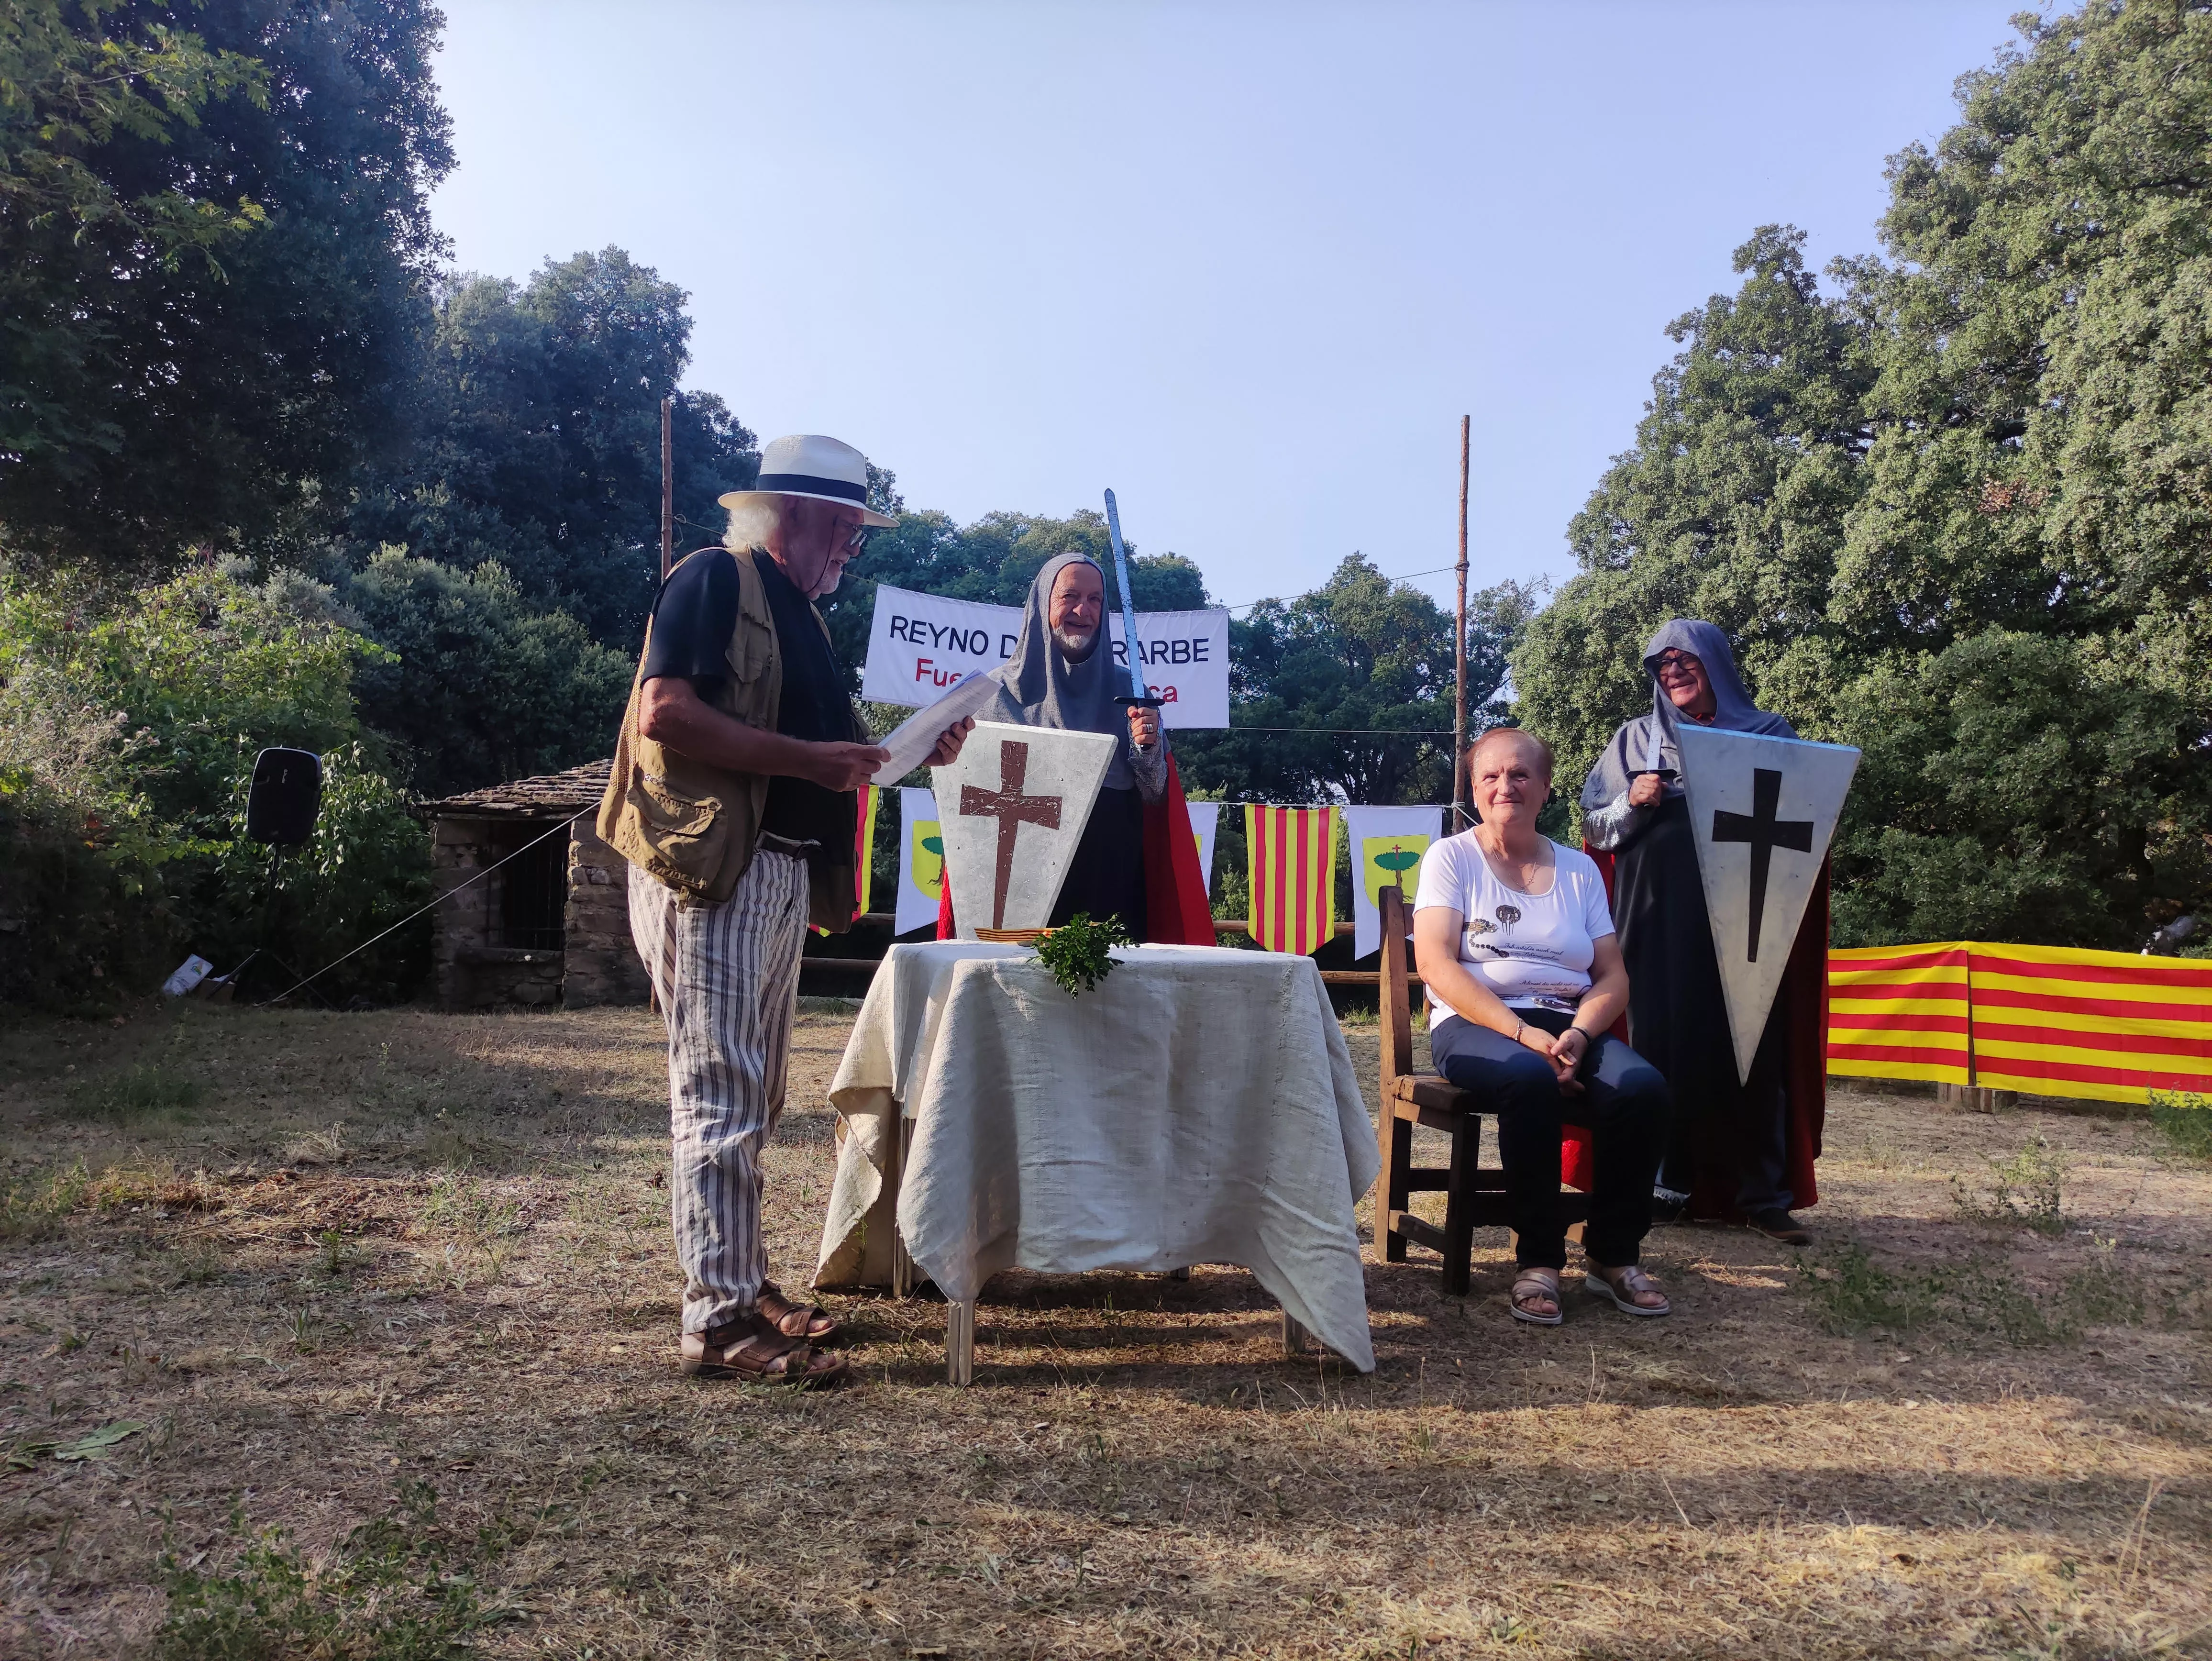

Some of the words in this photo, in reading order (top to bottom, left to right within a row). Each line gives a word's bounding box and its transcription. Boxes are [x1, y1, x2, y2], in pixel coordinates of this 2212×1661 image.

[890, 615, 989, 655] REYNO
[1000, 634, 1018, 659] D
[1111, 638, 1209, 665] RARBE
